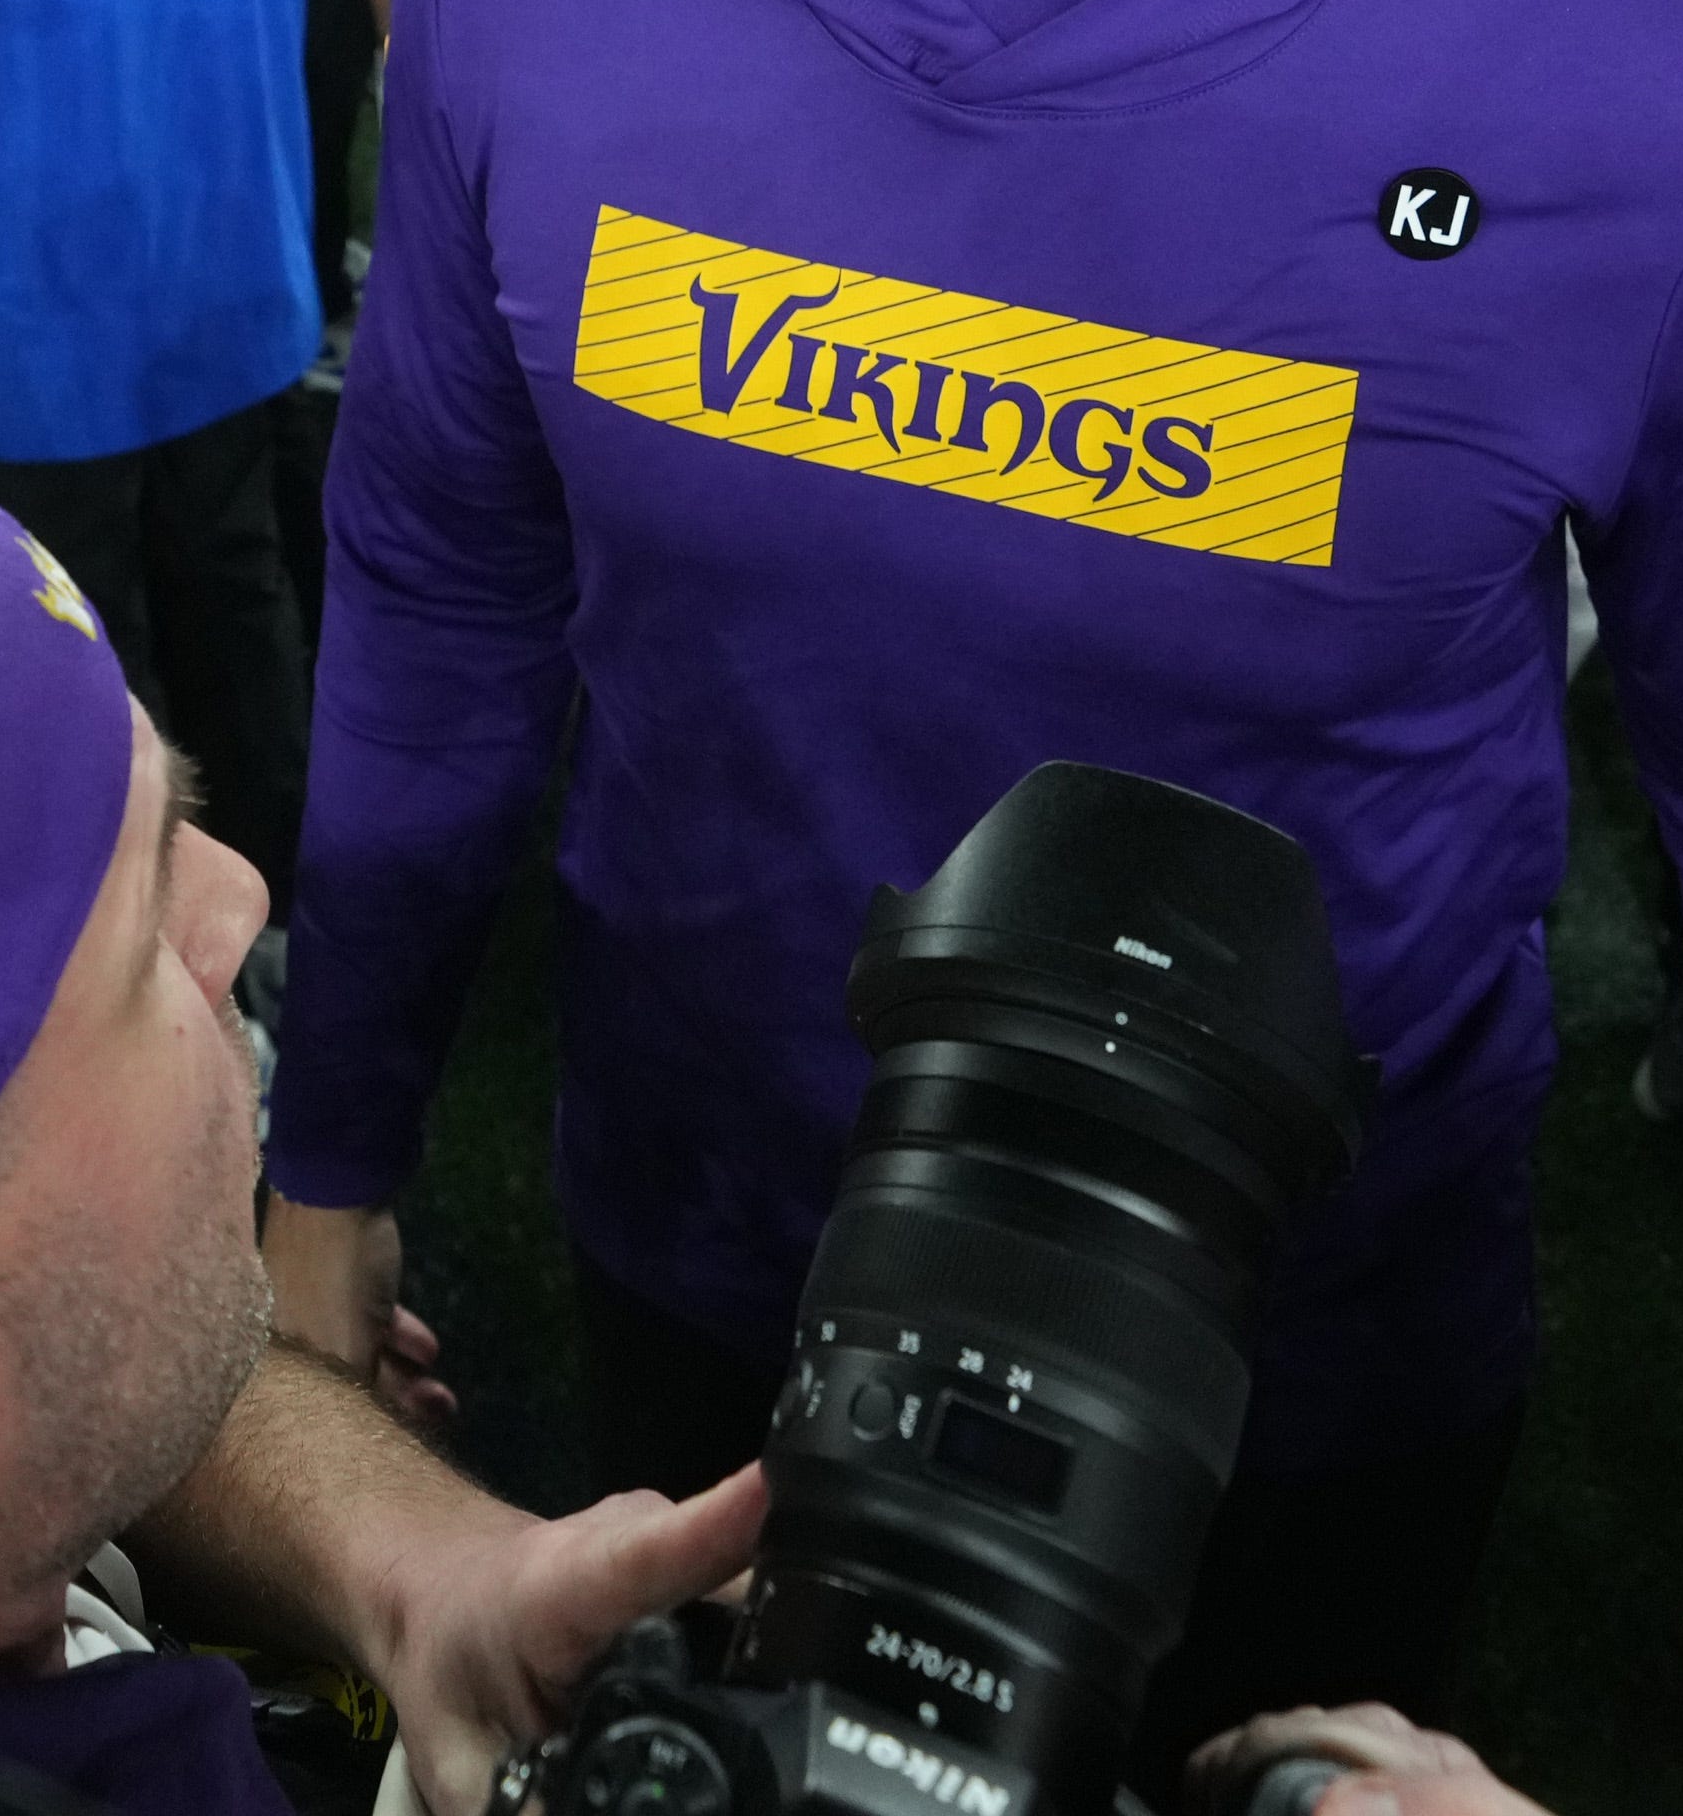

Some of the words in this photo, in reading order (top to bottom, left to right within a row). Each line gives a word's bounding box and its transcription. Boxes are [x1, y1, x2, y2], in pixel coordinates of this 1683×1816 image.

[1389, 184, 1470, 247] KJ
[1113, 935, 1173, 971] Nikon
[958, 1346, 986, 1374] 28
[1005, 1364, 1034, 1392] 24
[826, 1714, 1012, 1816] Nikon
